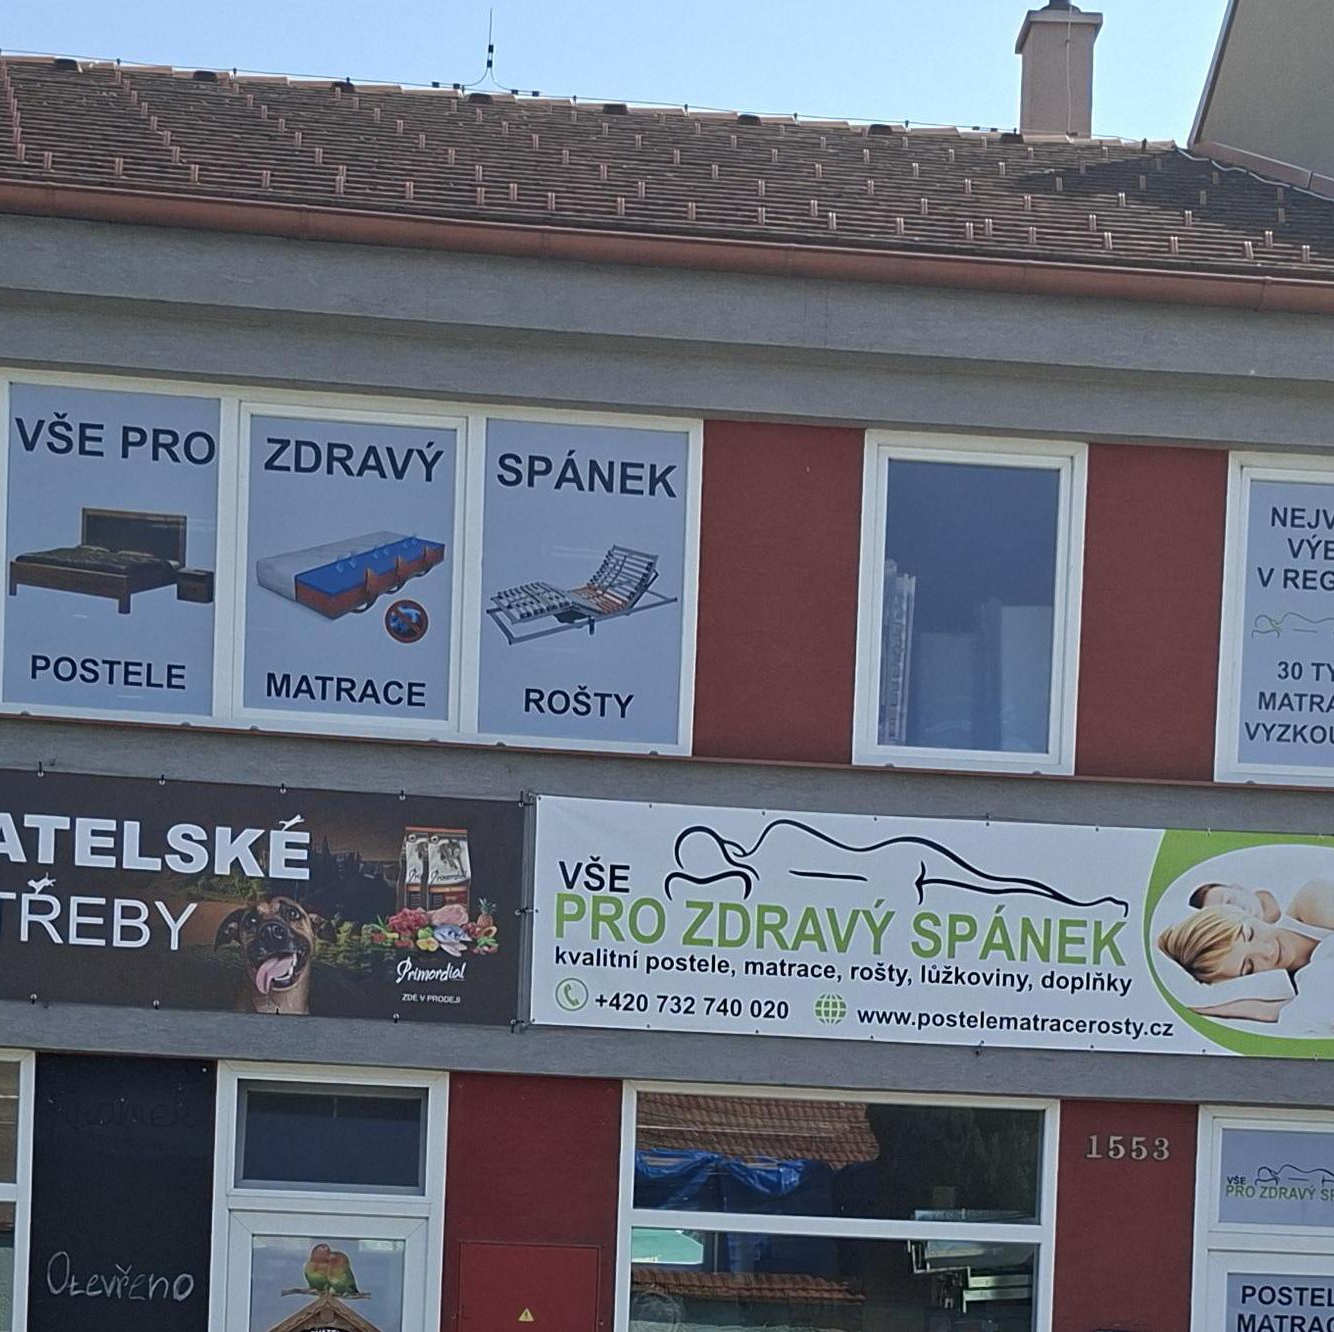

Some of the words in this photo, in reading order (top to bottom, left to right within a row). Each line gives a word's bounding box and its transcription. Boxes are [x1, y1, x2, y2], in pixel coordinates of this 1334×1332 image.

[14, 412, 106, 458] VŠE
[120, 426, 217, 467] PRO
[263, 437, 445, 483] ZDRAVÝ
[495, 450, 679, 499] SPÁNEK
[1257, 567, 1275, 588] V
[30, 655, 187, 691] POSTELE
[1277, 660, 1303, 681] 30
[266, 672, 427, 708] MATRACE
[523, 685, 635, 720] ROŠTY
[559, 856, 631, 893] VŠE
[555, 893, 666, 945] PRO
[682, 899, 896, 955] ZDRAVÝ
[910, 904, 1127, 967] SPÁNEK
[395, 956, 467, 983] Primordial
[554, 946, 639, 970] kvalitní
[646, 954, 736, 977] postele,
[744, 961, 842, 983] matrace,
[850, 961, 913, 987] rošty,
[920, 962, 1034, 992] lůžkoviny,
[1041, 969, 1133, 997] doplňky
[595, 992, 648, 1013] +420
[656, 994, 696, 1016] 732
[704, 997, 743, 1018] 740
[750, 999, 789, 1020] 020
[857, 1005, 1175, 1040] www.postelematracerosty.cz
[1085, 1134, 1171, 1162] 1553
[1226, 1174, 1247, 1185] VŠE
[1226, 1184, 1255, 1199] PRO
[1259, 1185, 1316, 1201] ZDRAVÝ
[47, 1250, 195, 1301] Otevřeno
